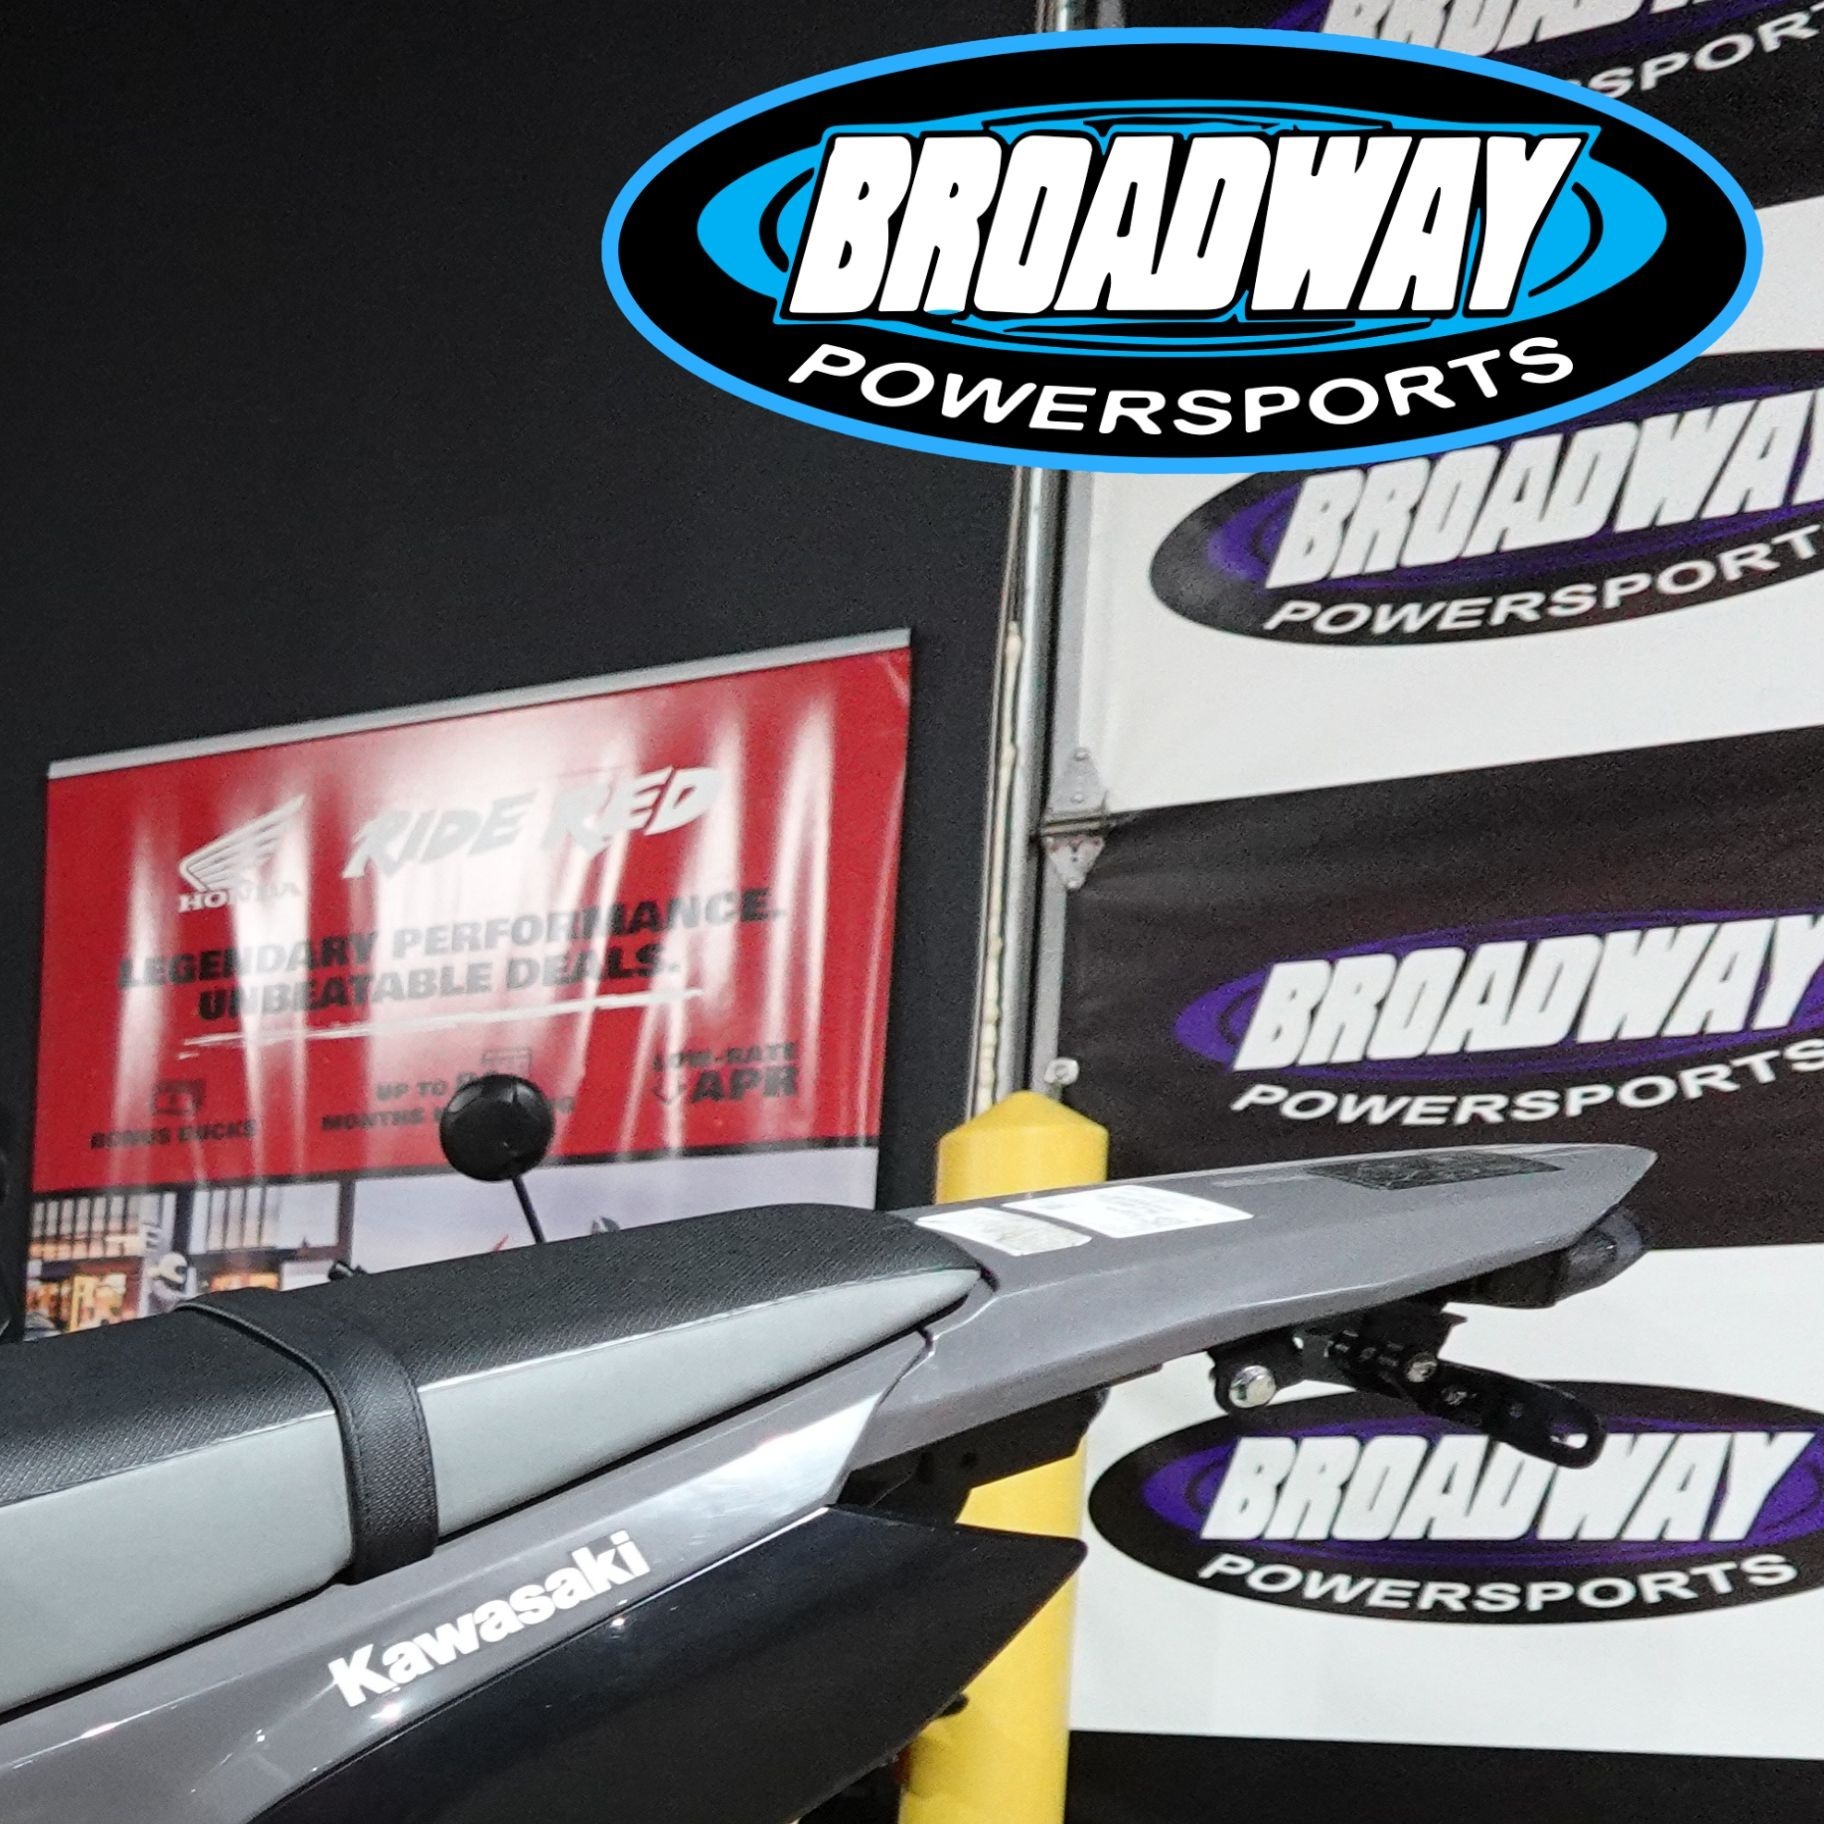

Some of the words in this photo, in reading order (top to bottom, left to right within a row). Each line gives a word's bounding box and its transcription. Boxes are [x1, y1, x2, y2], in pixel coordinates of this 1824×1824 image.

[342, 791, 537, 879] RIDE
[542, 765, 725, 858] RED
[119, 932, 379, 990] LEGENDARY
[391, 886, 785, 959] PERFORMANCE.
[198, 958, 493, 1020] UNBEATABLE
[507, 942, 680, 991] DEALS.
[691, 1066, 800, 1104] APR
[1230, 1038, 1824, 1126] POWERSPORTS
[1201, 1432, 1815, 1541] BROADWAY
[328, 1530, 651, 1708] Kawasaki
[1198, 1553, 1798, 1612] POWERSPORTS
